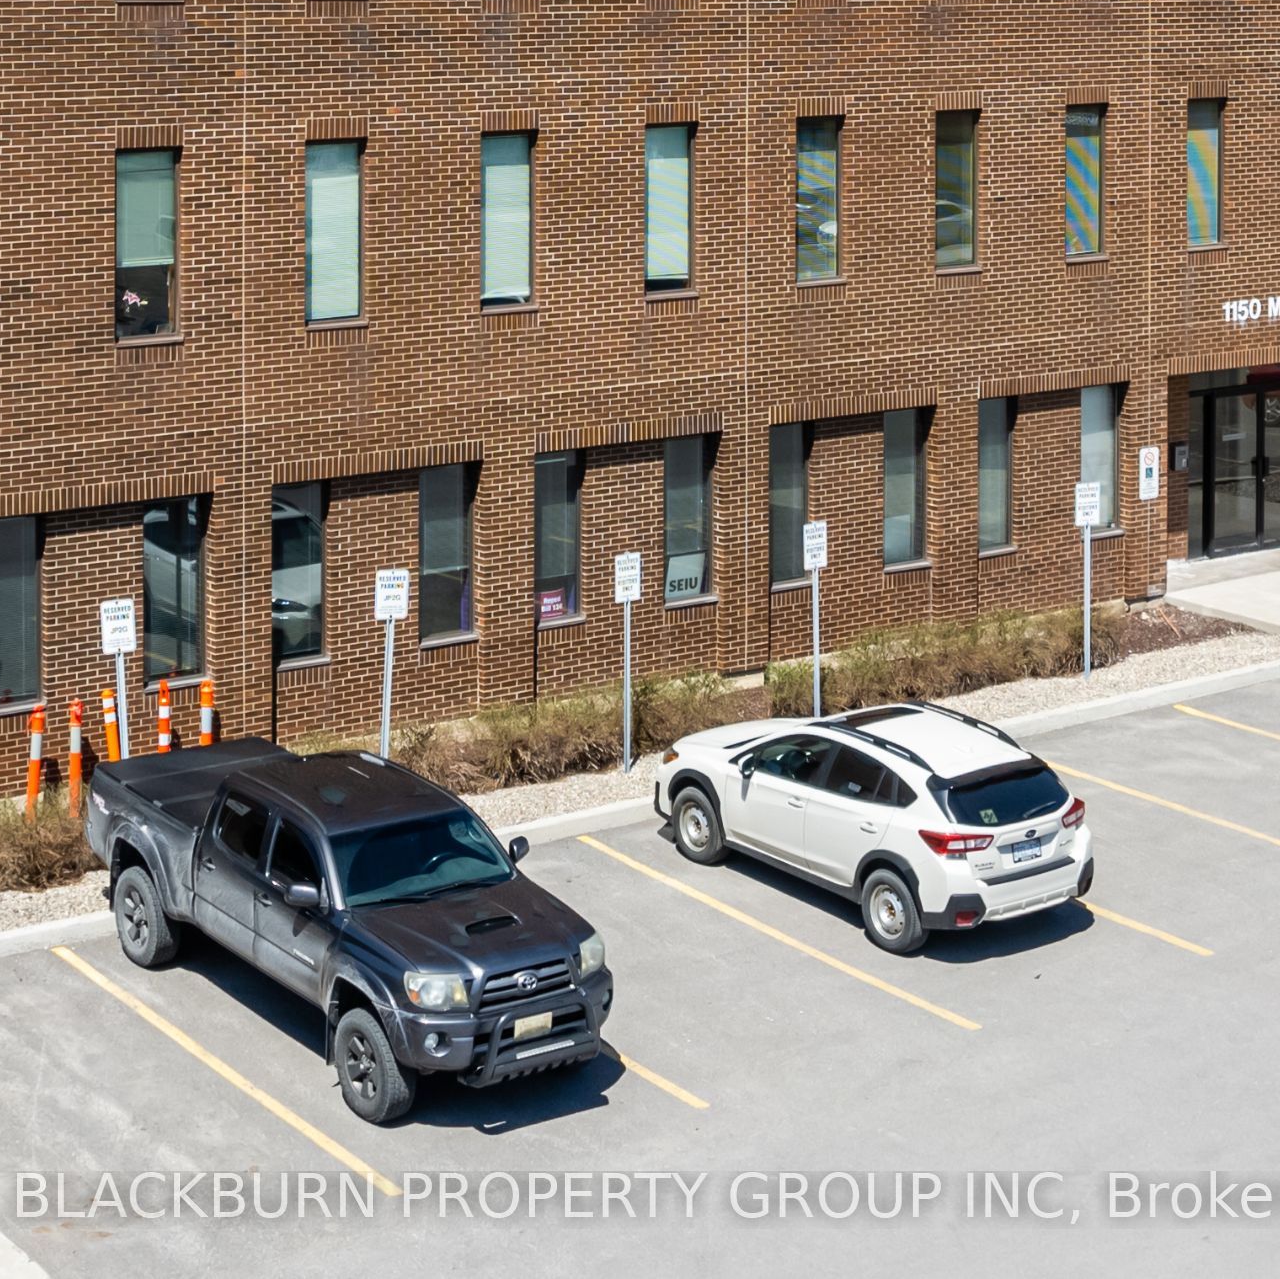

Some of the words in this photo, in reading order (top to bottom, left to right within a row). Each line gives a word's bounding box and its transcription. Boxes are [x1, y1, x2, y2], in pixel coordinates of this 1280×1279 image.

[1223, 298, 1262, 322] 1150
[380, 582, 405, 590] PARKING
[668, 576, 698, 593] SEIU
[103, 605, 132, 615] RESERVED
[106, 613, 130, 621] PARKING
